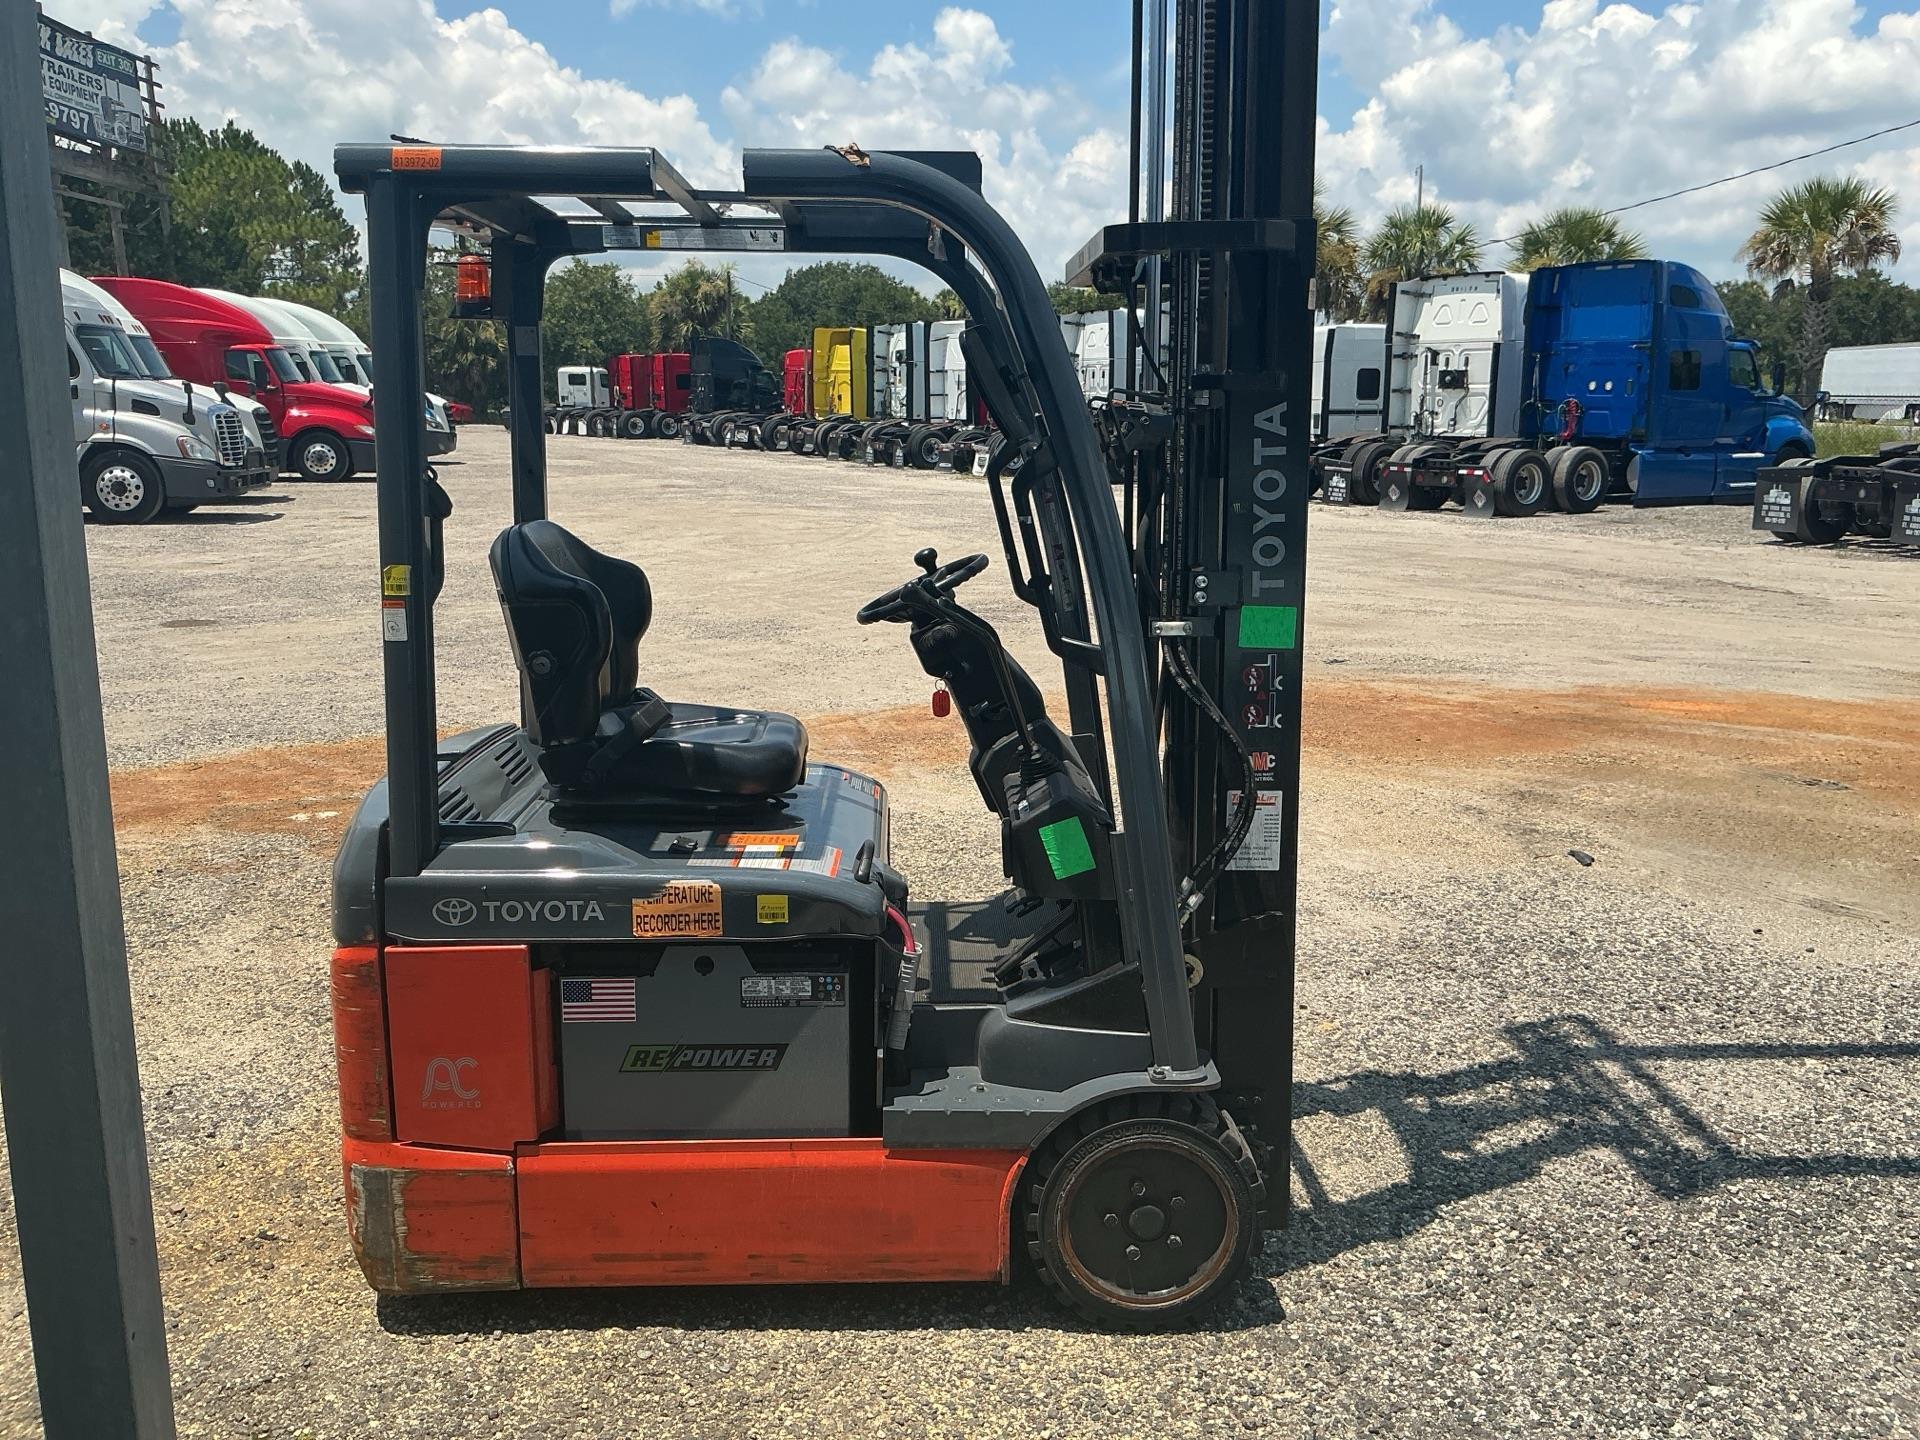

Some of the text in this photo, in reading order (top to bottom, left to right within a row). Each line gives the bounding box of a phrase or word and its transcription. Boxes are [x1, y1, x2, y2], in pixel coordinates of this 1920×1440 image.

[97, 51, 116, 68] EXIT
[40, 57, 103, 91] TRAILERS
[48, 75, 100, 105] EQUIPMENT
[44, 102, 90, 134] -9797
[393, 156, 440, 168] 813972-02
[1251, 401, 1288, 598] TOYOTA
[482, 900, 605, 922] TOYOTA
[635, 912, 721, 933] RECORDER HERE
[422, 1057, 480, 1100] AC
[421, 1101, 481, 1109] POWERED
